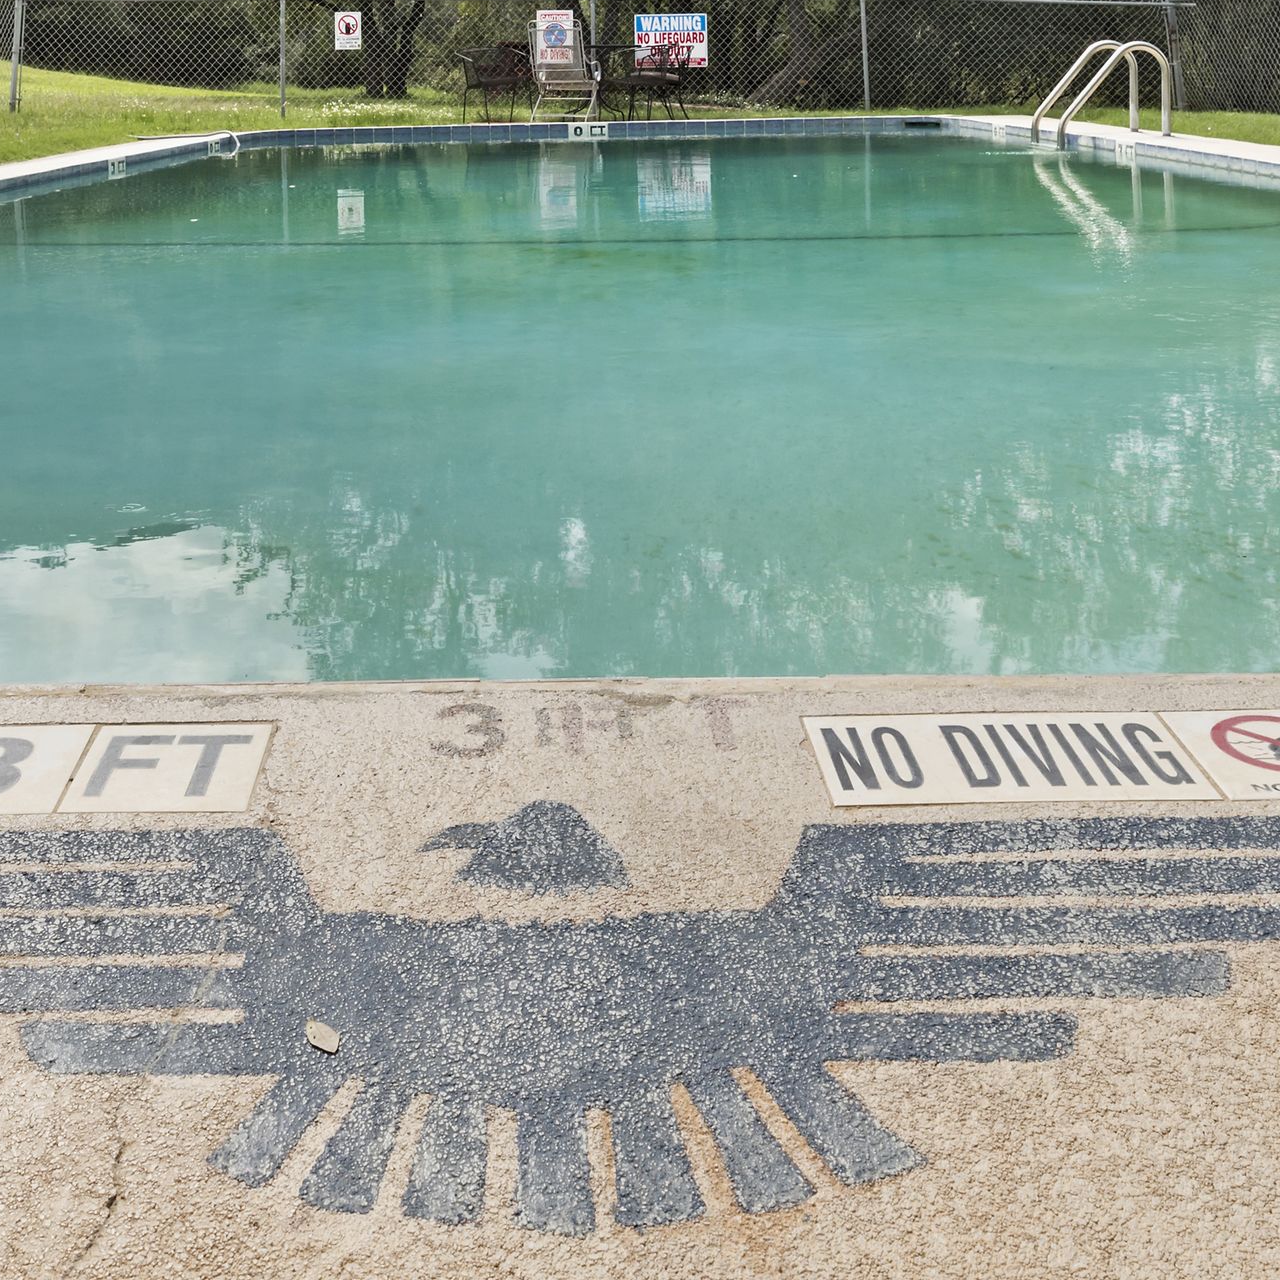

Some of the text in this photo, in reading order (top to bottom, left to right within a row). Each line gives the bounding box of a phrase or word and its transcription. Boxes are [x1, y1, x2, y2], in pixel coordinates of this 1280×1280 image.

[637, 32, 705, 44] NO LIFEGUARD
[640, 16, 702, 31] WARNING
[82, 734, 254, 798] FT
[820, 722, 1195, 791] NO DIVING
